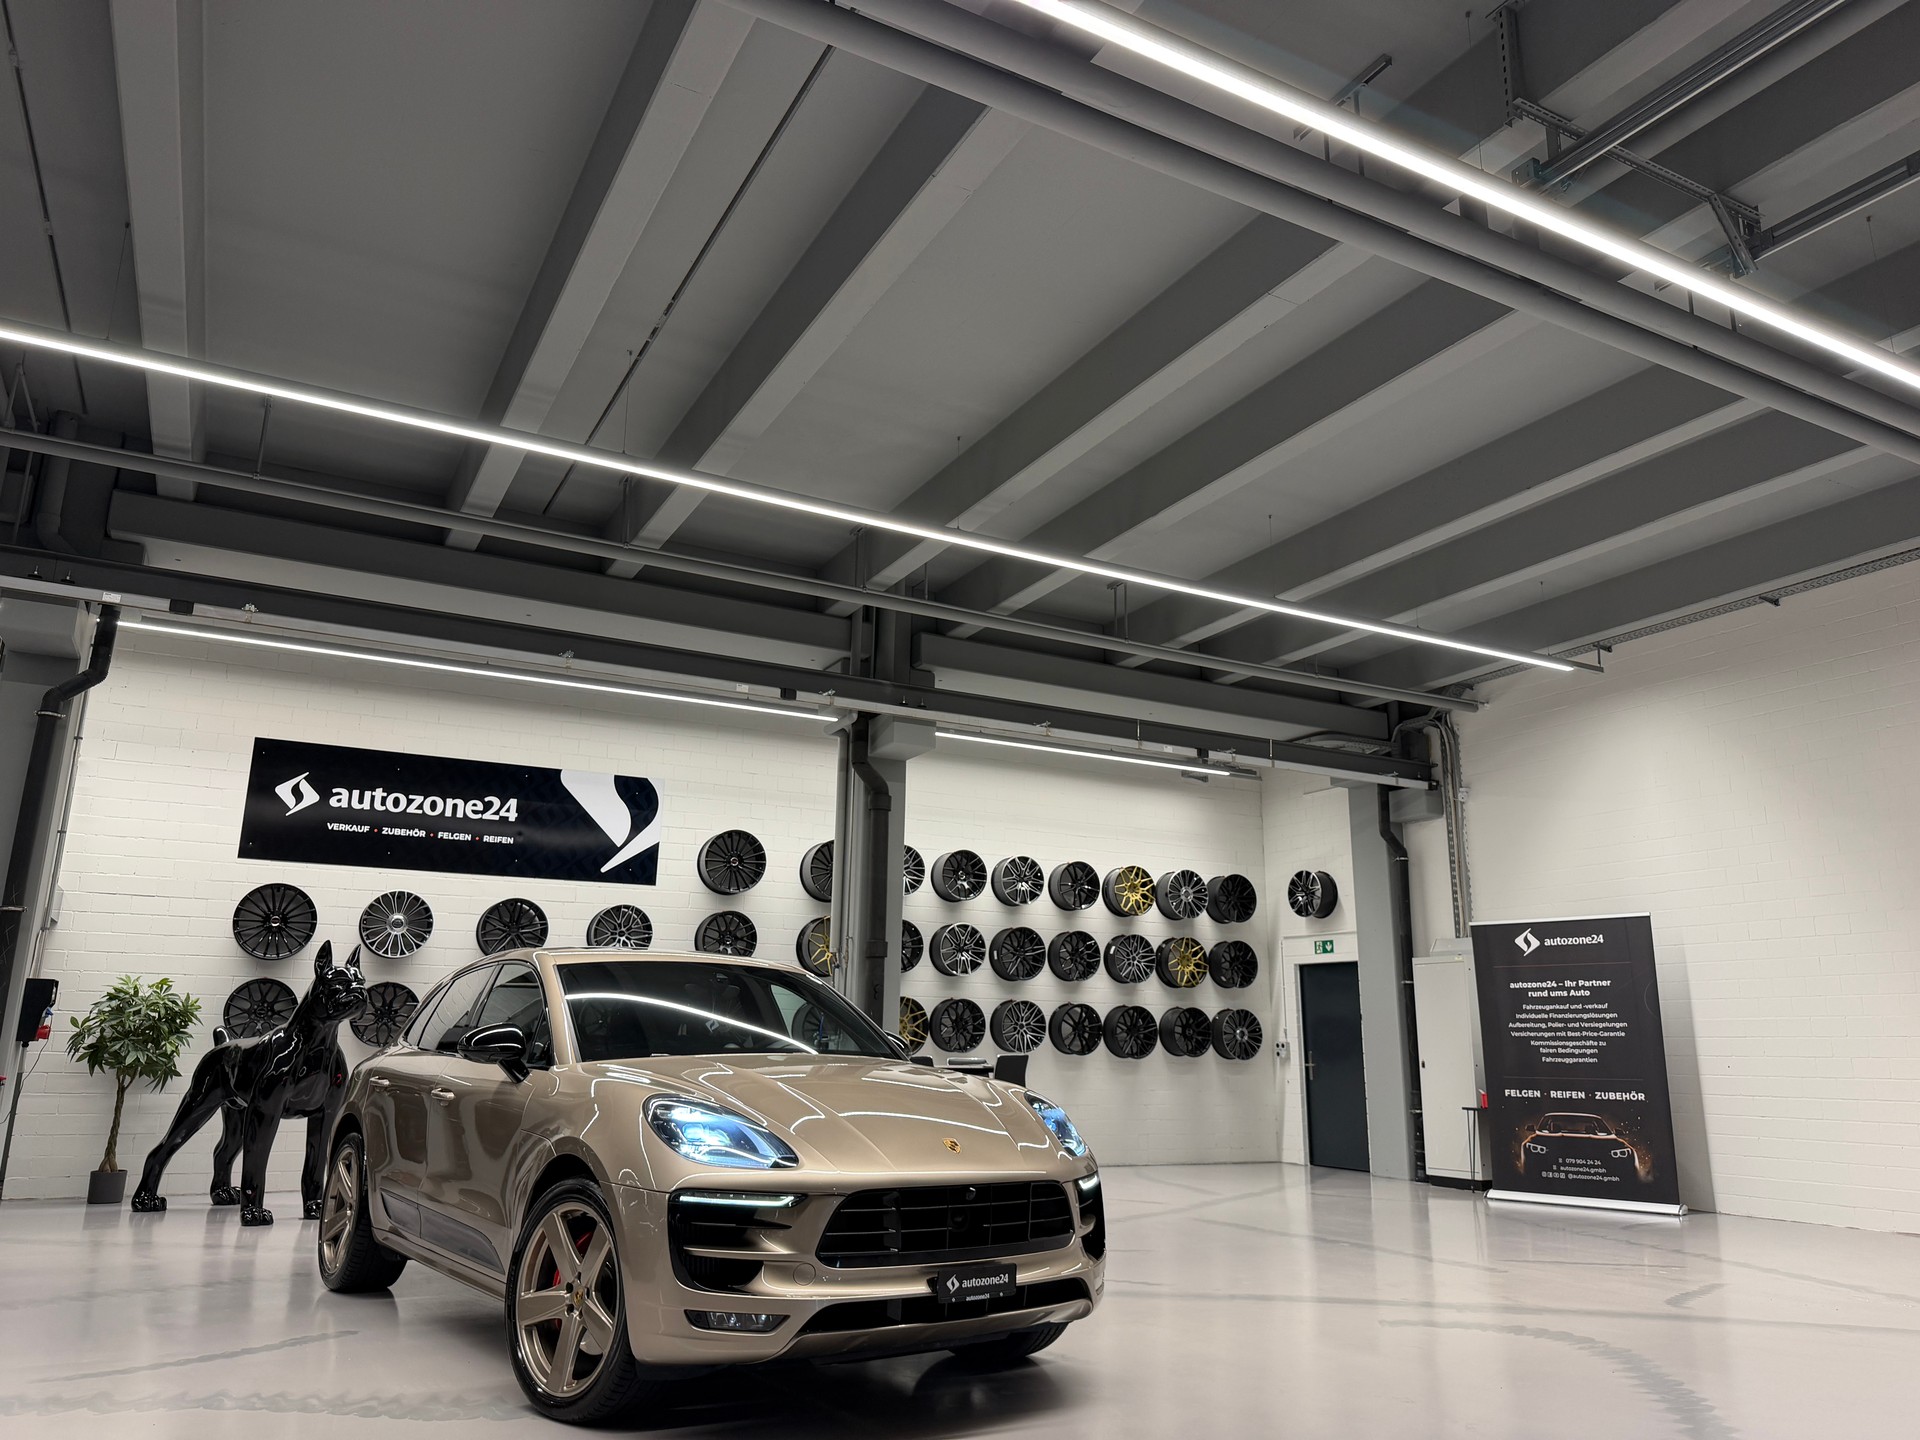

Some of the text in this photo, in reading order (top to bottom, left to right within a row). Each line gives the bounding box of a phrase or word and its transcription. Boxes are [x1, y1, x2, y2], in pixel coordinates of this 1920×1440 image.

[329, 786, 519, 822] autozone24
[326, 822, 514, 845] VERKAUF ZUBEHÖR FELGEN REIFEN
[1544, 934, 1604, 946] autozone24
[1509, 981, 1557, 989] autozone24
[1564, 980, 1577, 988] Ihr
[1569, 989, 1591, 997] Auto
[1504, 1089, 1645, 1101] FELGEN REIFEN ZUBEHÖR
[1560, 1165, 1607, 1174] autozone24.gmbh
[961, 1273, 1009, 1288] autozone24
[966, 1293, 990, 1301] autozone24
